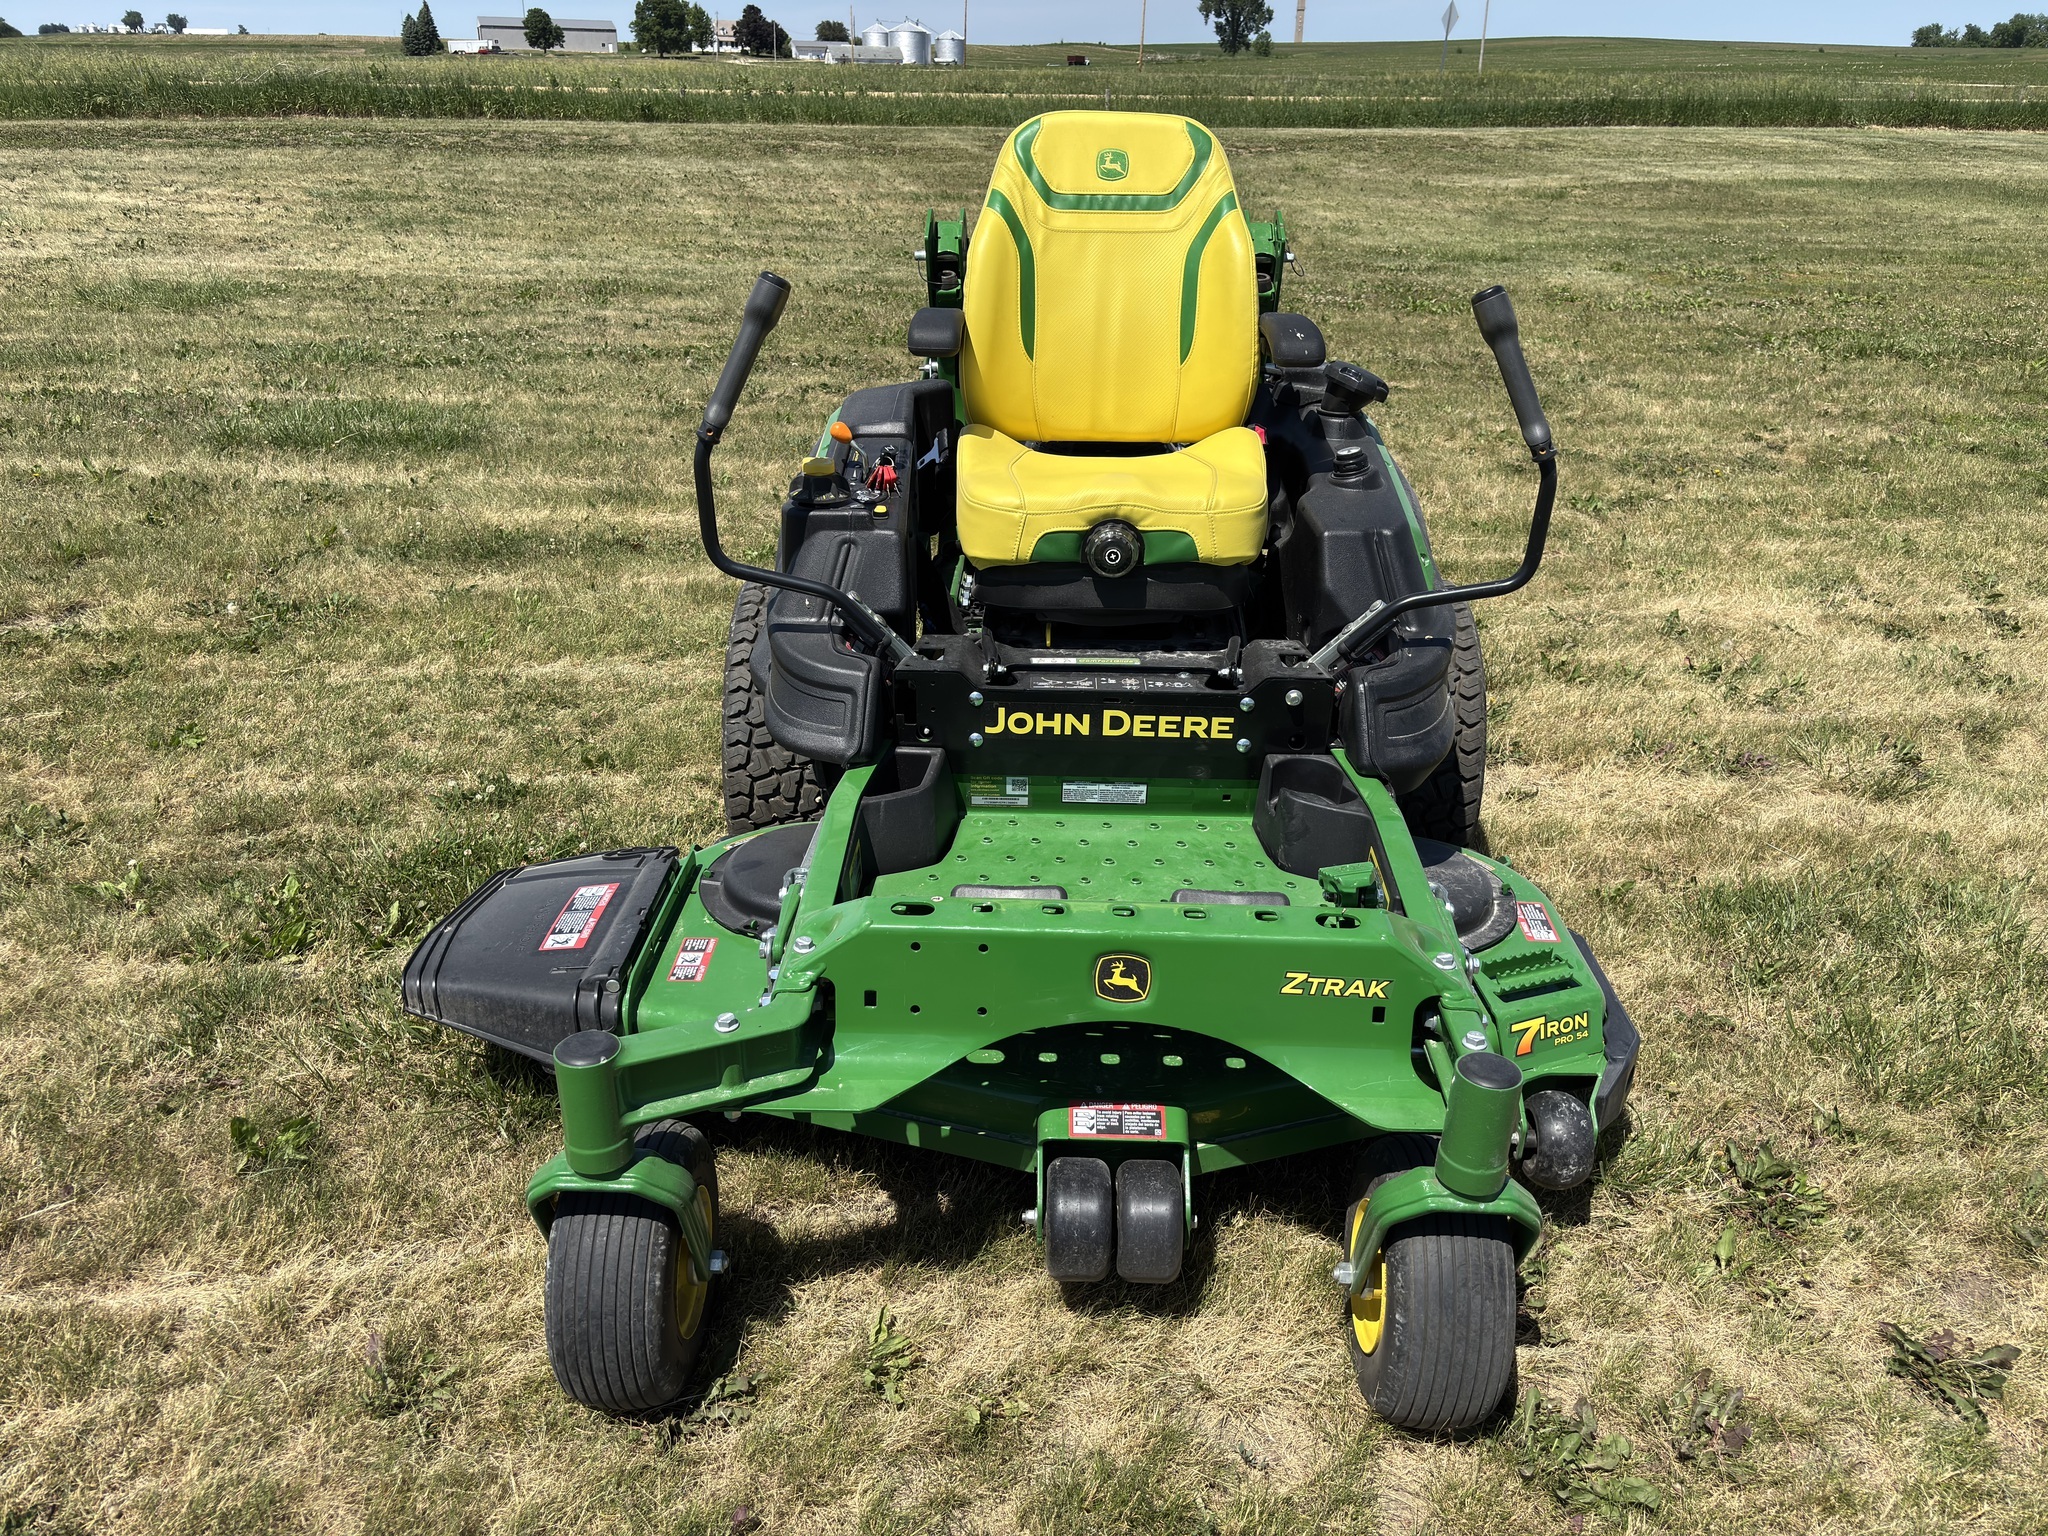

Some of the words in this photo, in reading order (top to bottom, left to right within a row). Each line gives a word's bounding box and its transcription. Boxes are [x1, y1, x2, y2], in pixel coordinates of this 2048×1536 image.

[985, 707, 1090, 736] JOHN
[1102, 709, 1235, 739] DEERE
[1280, 971, 1393, 999] ZTRAK
[1554, 1034, 1574, 1046] PRO
[1576, 1030, 1589, 1040] 54
[1089, 1101, 1114, 1109] DANGER
